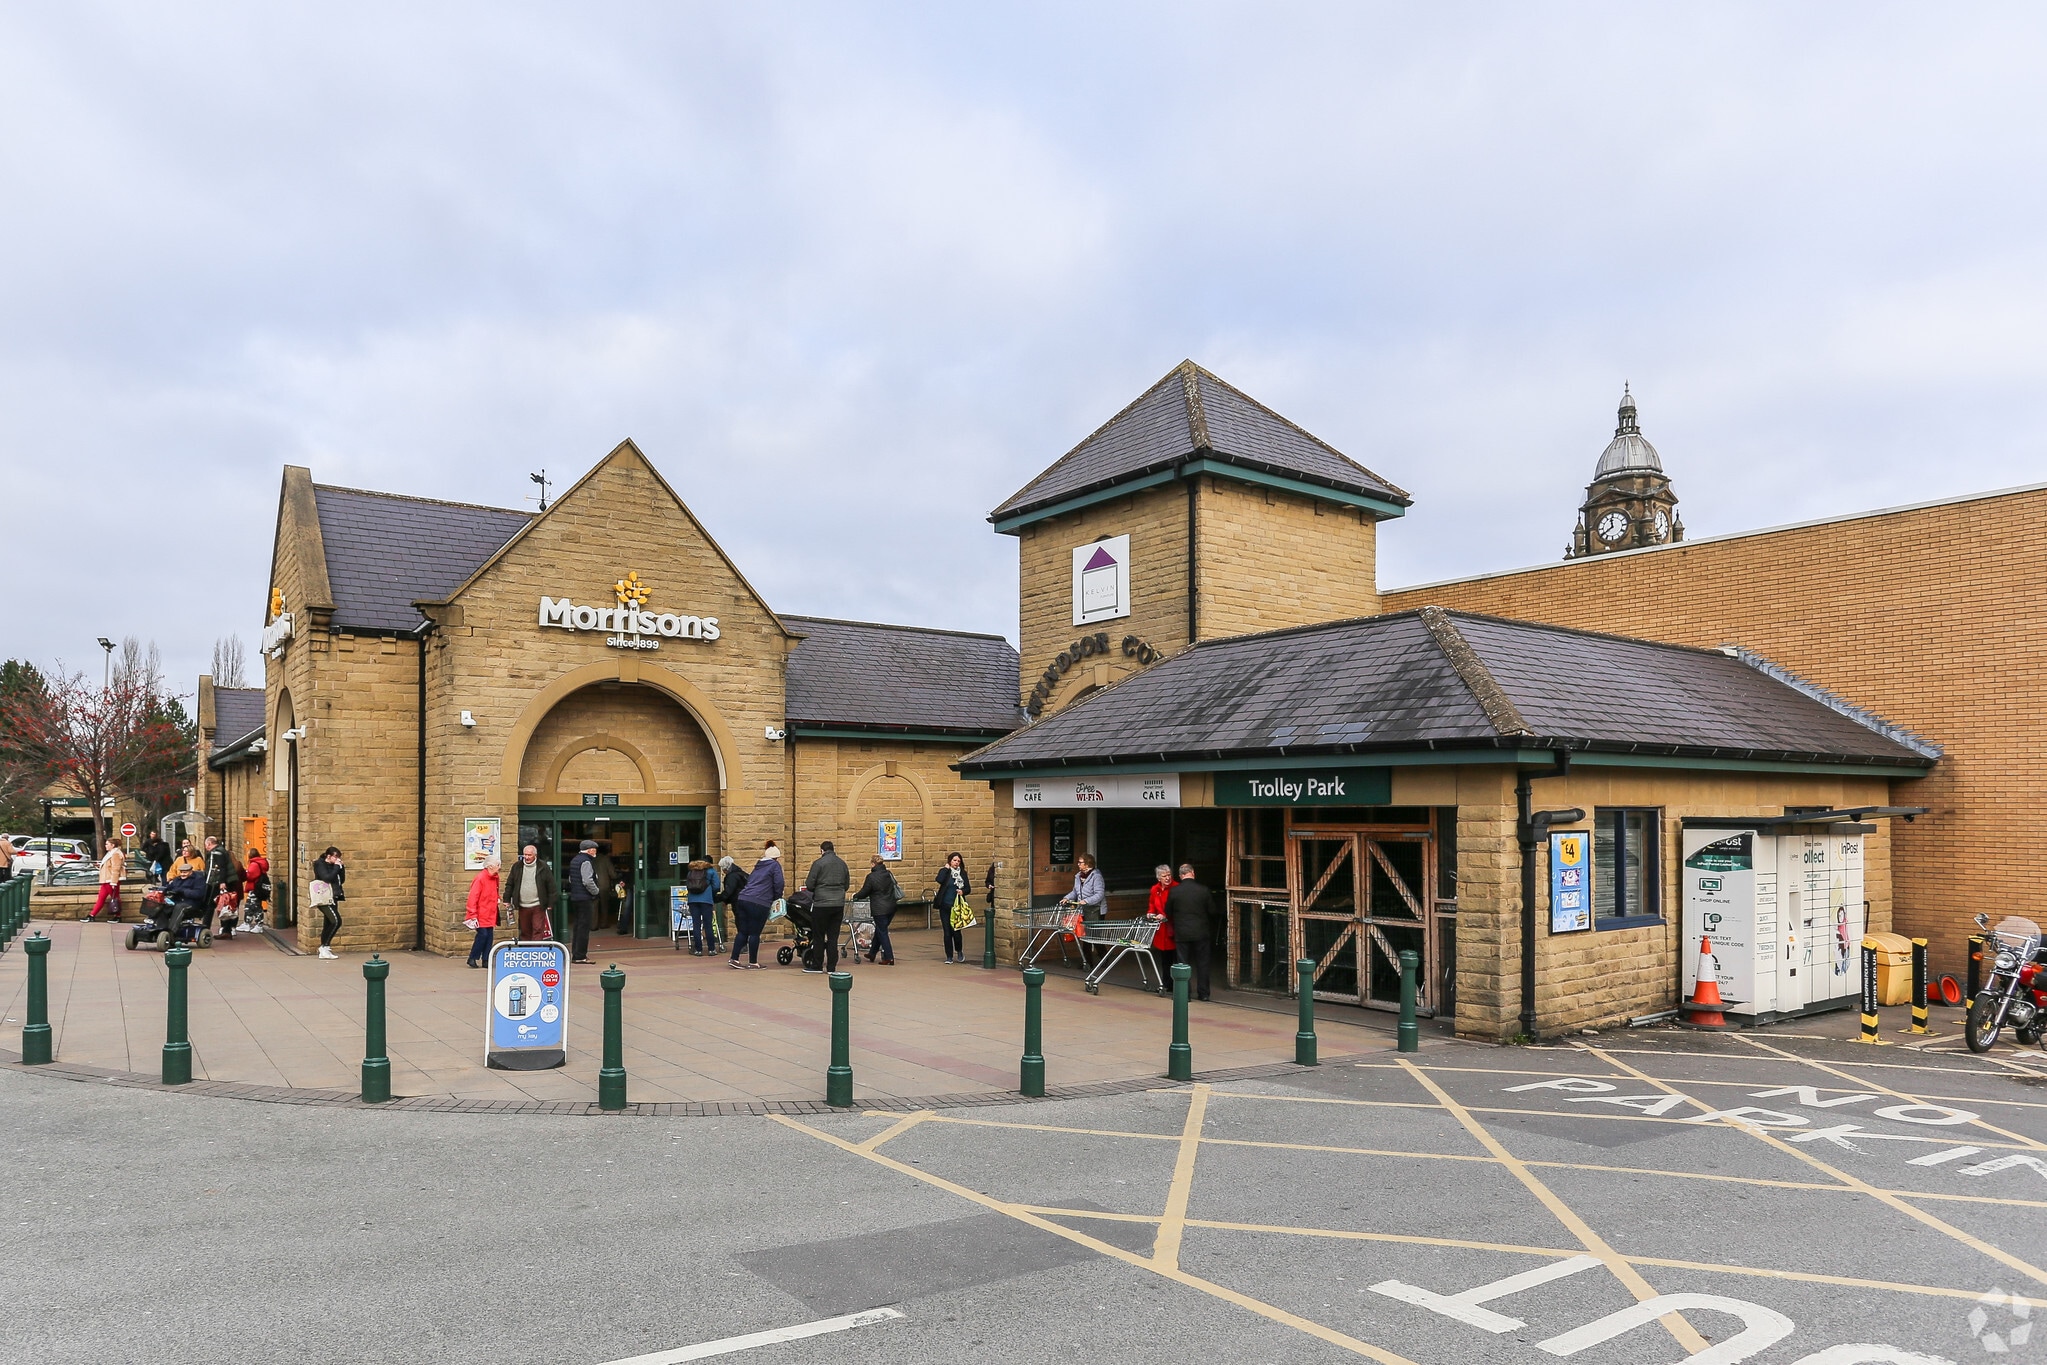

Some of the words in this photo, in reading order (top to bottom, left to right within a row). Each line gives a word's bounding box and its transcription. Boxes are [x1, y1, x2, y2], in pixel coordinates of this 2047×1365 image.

[1086, 585, 1115, 596] KELVIN
[538, 596, 721, 640] Morrisons
[606, 637, 634, 648] Since
[636, 639, 660, 650] 1899
[1027, 632, 1110, 716] WINDSOR
[1076, 782, 1097, 794] Free
[1142, 789, 1165, 800] CAFÉ
[1248, 777, 1303, 802] Trolley
[1307, 775, 1346, 796] Park
[1023, 791, 1042, 802] CAFÉ
[1076, 793, 1097, 802] WI-FI
[1565, 844, 1575, 859] £4
[1840, 842, 1859, 855] InPost
[1804, 850, 1825, 864] ollect
[504, 951, 556, 961] PRECISION
[520, 960, 556, 968] CUTTING
[1747, 1085, 1981, 1126] NO
